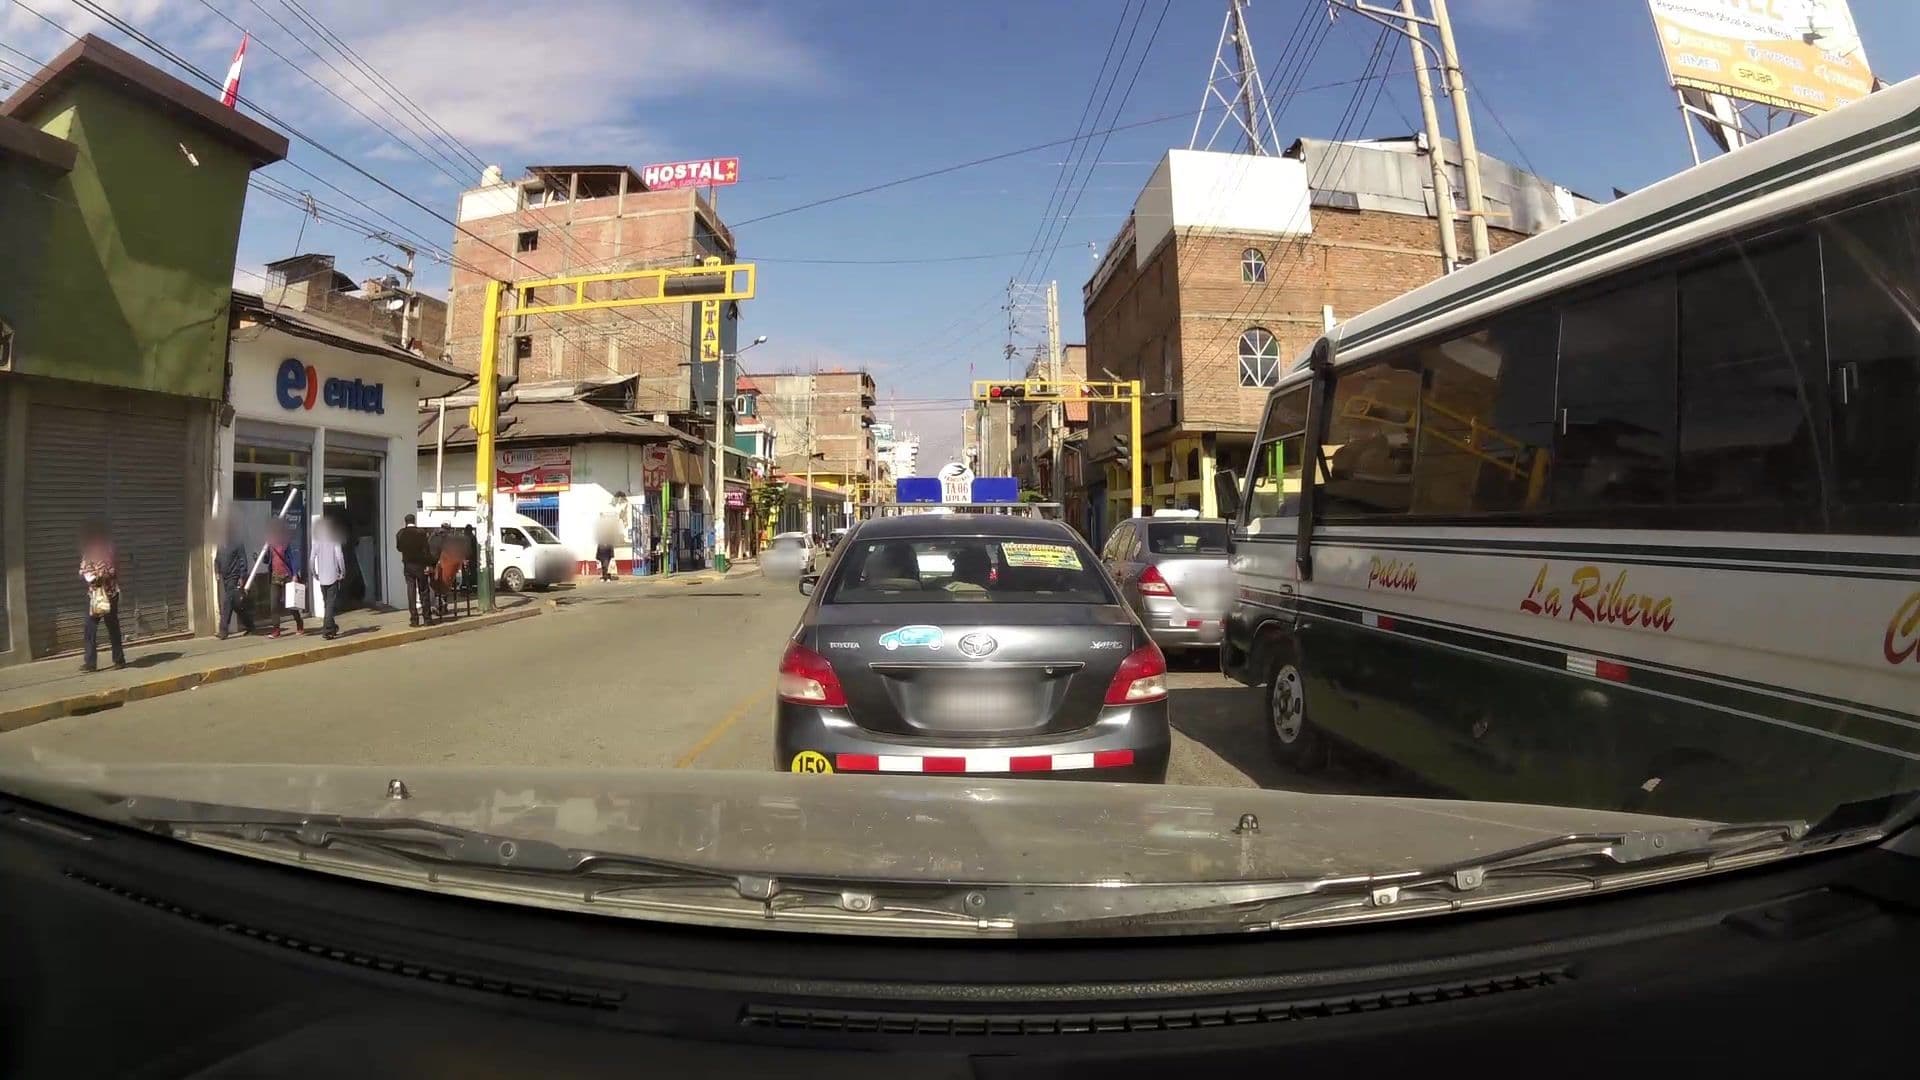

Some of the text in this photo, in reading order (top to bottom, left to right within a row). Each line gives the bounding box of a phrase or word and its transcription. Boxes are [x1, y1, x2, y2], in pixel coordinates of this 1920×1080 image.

[645, 161, 725, 186] HOSTAL
[324, 377, 384, 414] entel
[1520, 562, 1675, 632] La Ribera
